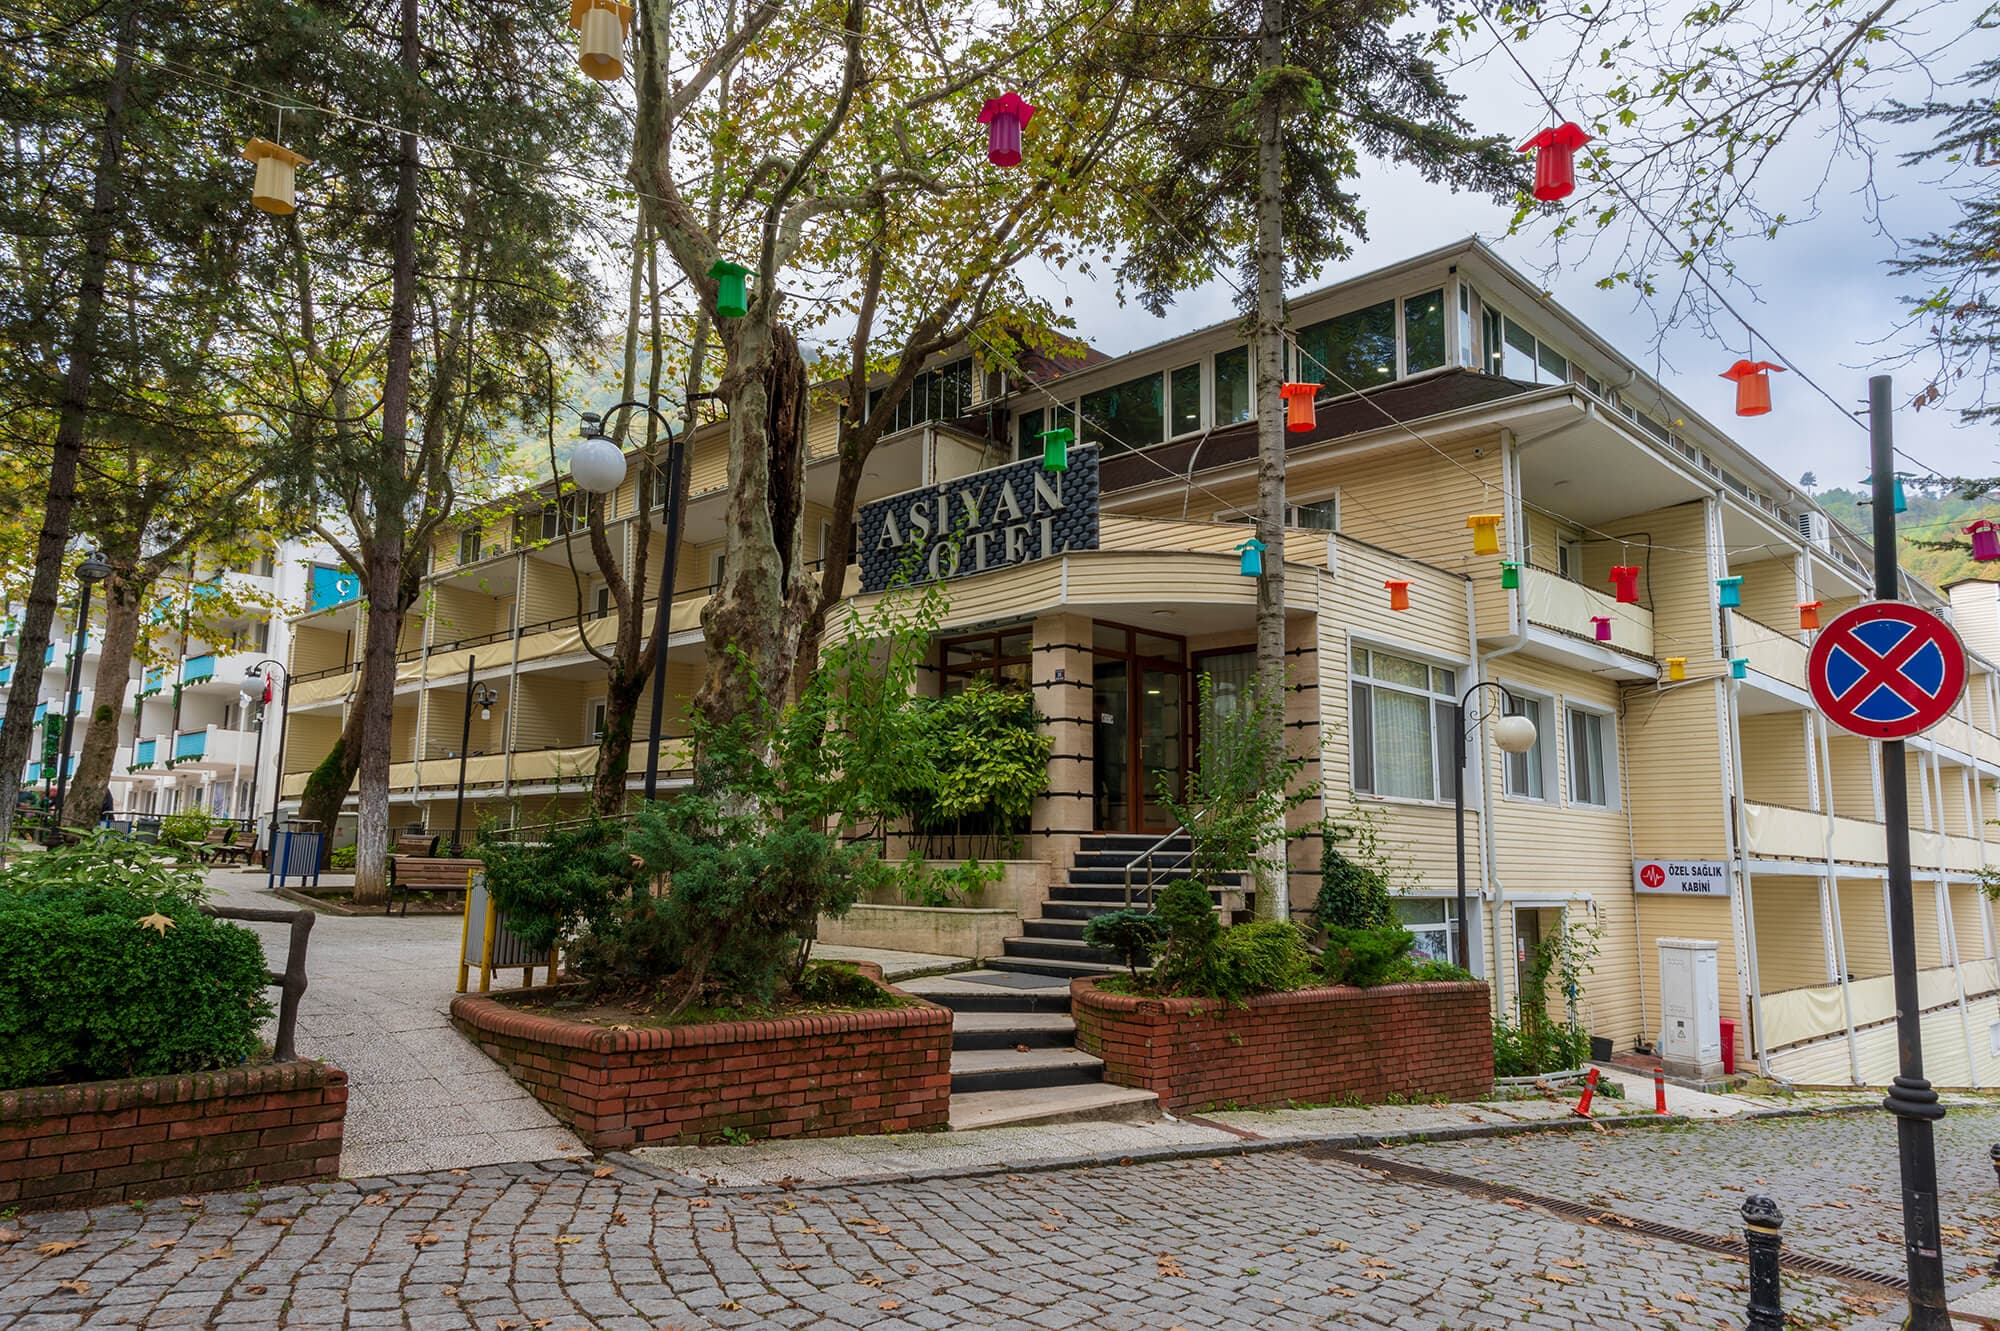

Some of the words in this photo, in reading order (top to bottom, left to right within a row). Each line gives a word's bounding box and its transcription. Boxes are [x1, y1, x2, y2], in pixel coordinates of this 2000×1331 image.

[877, 470, 1067, 551] ASİYAN
[928, 515, 1070, 580] OTEL
[1668, 863, 1690, 876] ÖZEL
[1691, 863, 1722, 877] SAĞLIK
[1681, 880, 1711, 893] KABİNİ
